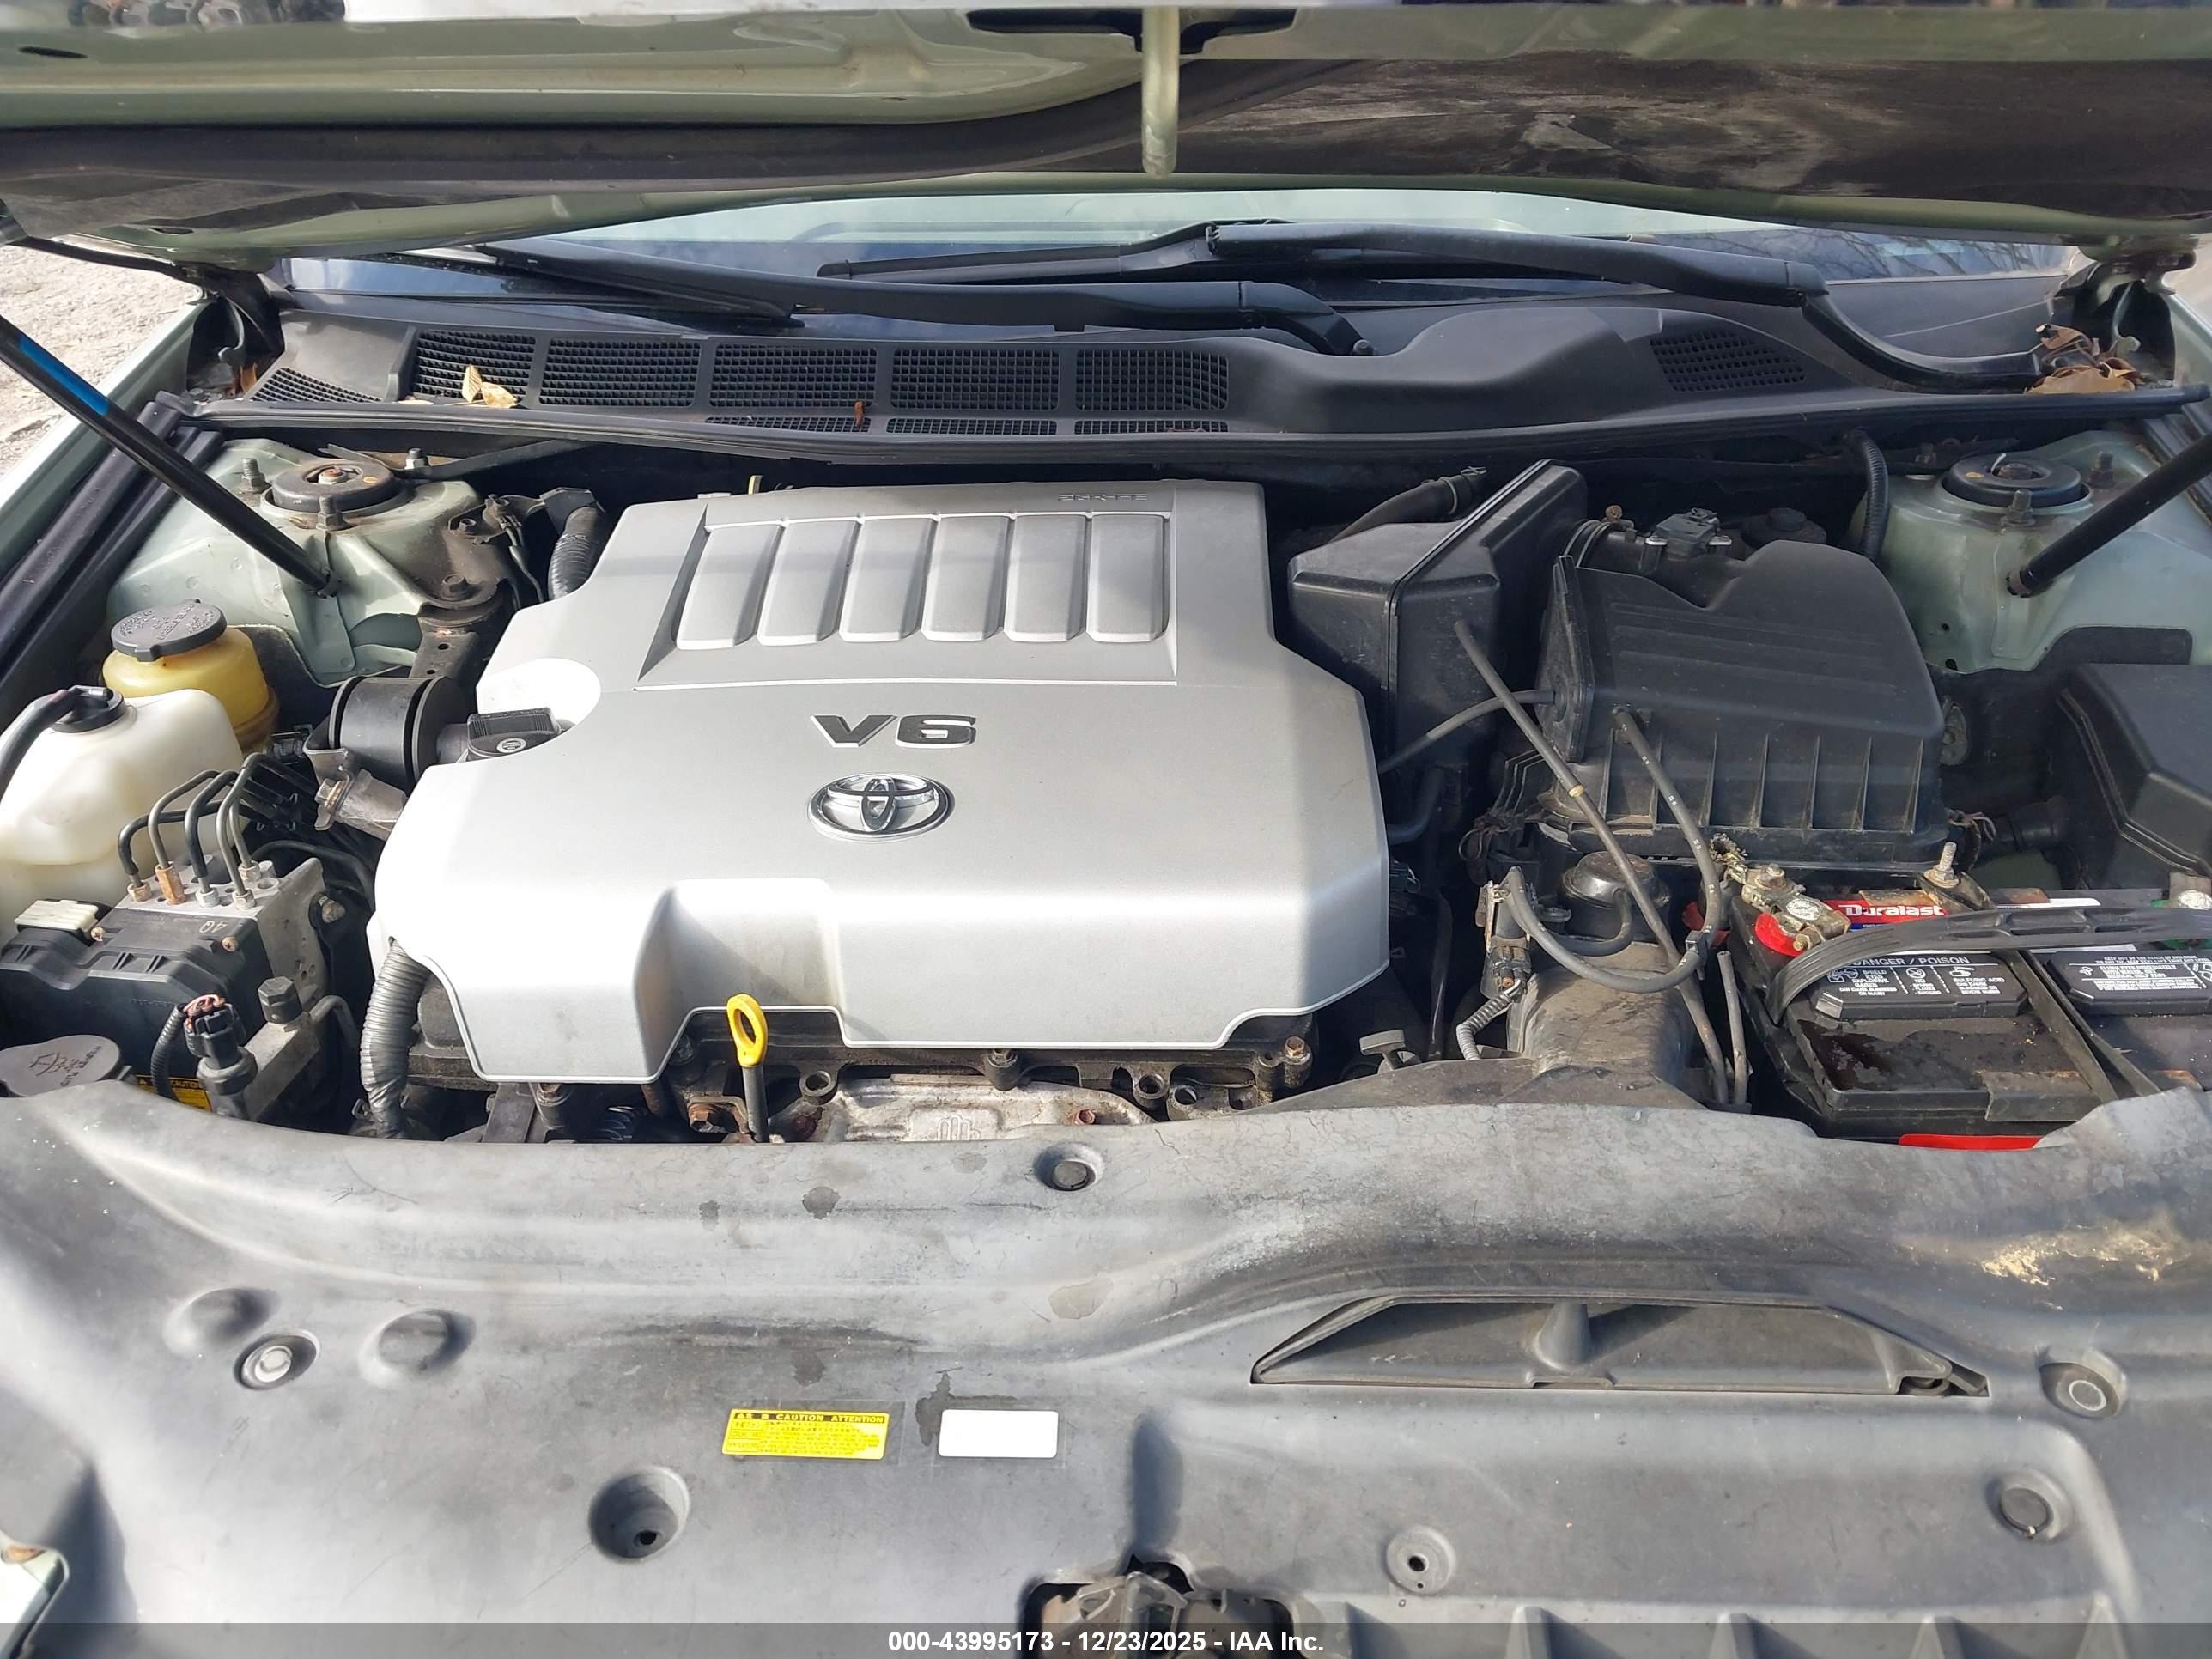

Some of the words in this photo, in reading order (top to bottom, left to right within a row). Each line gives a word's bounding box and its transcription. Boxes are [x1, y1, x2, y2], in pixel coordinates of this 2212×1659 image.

[810, 714, 977, 748] V6
[1838, 904, 1945, 917] Duralast
[170, 1079, 199, 1089] CAUTIO
[776, 1413, 824, 1422] CAUTION
[831, 1414, 884, 1423] ATTENTION
